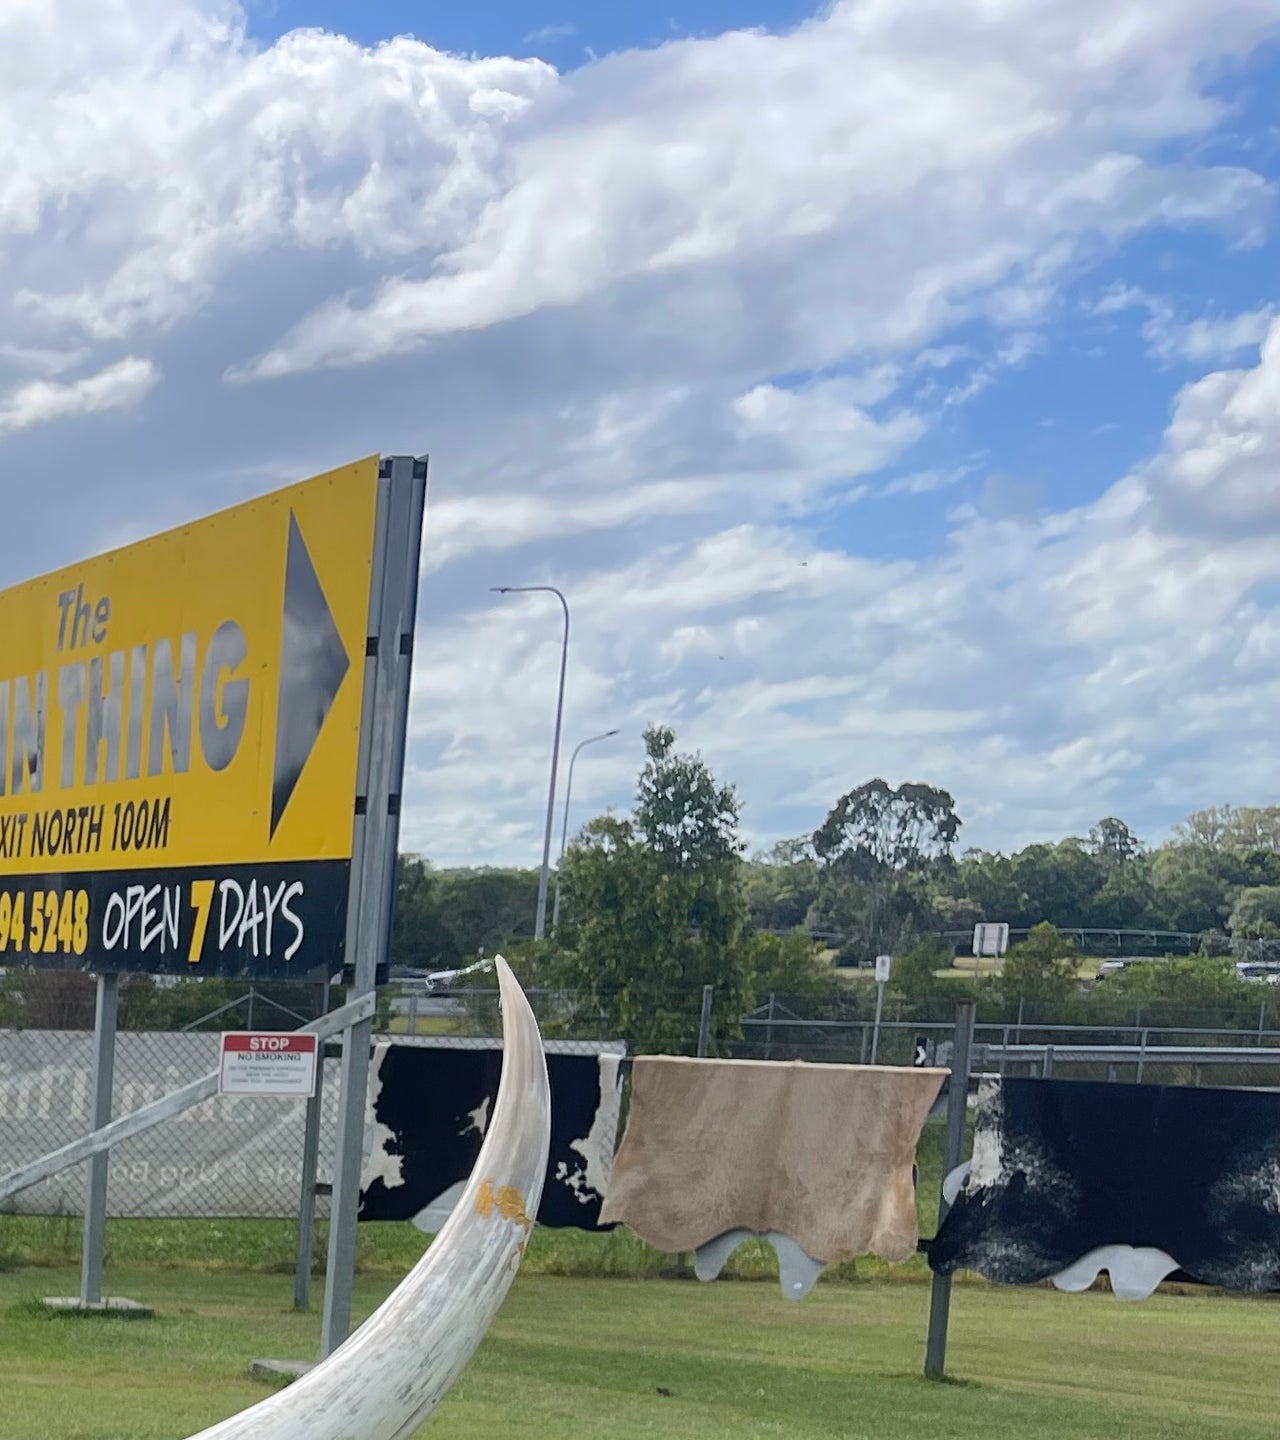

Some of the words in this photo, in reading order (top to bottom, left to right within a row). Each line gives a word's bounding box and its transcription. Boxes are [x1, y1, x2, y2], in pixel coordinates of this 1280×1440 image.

[57, 583, 111, 653] The
[58, 620, 250, 790] THING
[30, 804, 105, 858] NORTH
[111, 797, 172, 852] 100M
[29, 889, 89, 955] 5248
[102, 884, 181, 954] OPEN
[188, 879, 216, 963] 7
[219, 878, 304, 961] DAYS
[238, 1053, 252, 1061] NO
[255, 1053, 301, 1062] SMOKING
[250, 1037, 290, 1051] STOP
